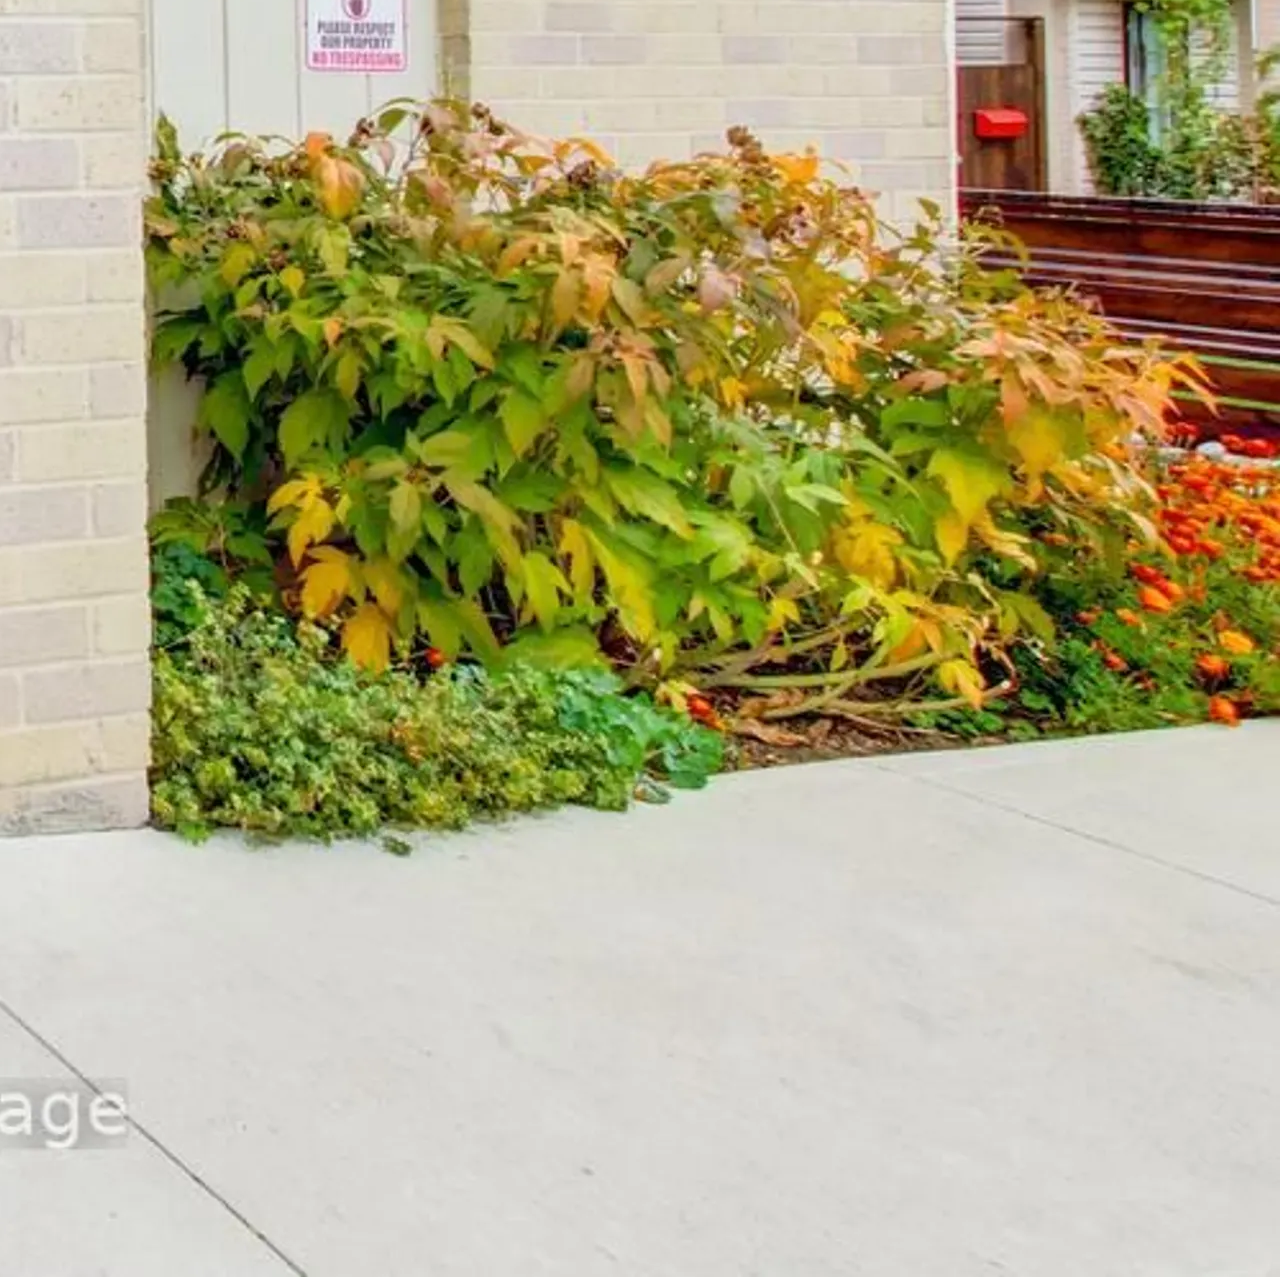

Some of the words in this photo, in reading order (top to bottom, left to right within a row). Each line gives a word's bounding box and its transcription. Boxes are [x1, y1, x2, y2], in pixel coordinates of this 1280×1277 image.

[318, 21, 351, 34] PLEASE
[354, 22, 395, 36] RESPECT
[320, 35, 341, 49] OUR
[343, 36, 393, 50] PROPERTY
[313, 51, 328, 64] NO
[330, 52, 401, 67] TRESPASSING
